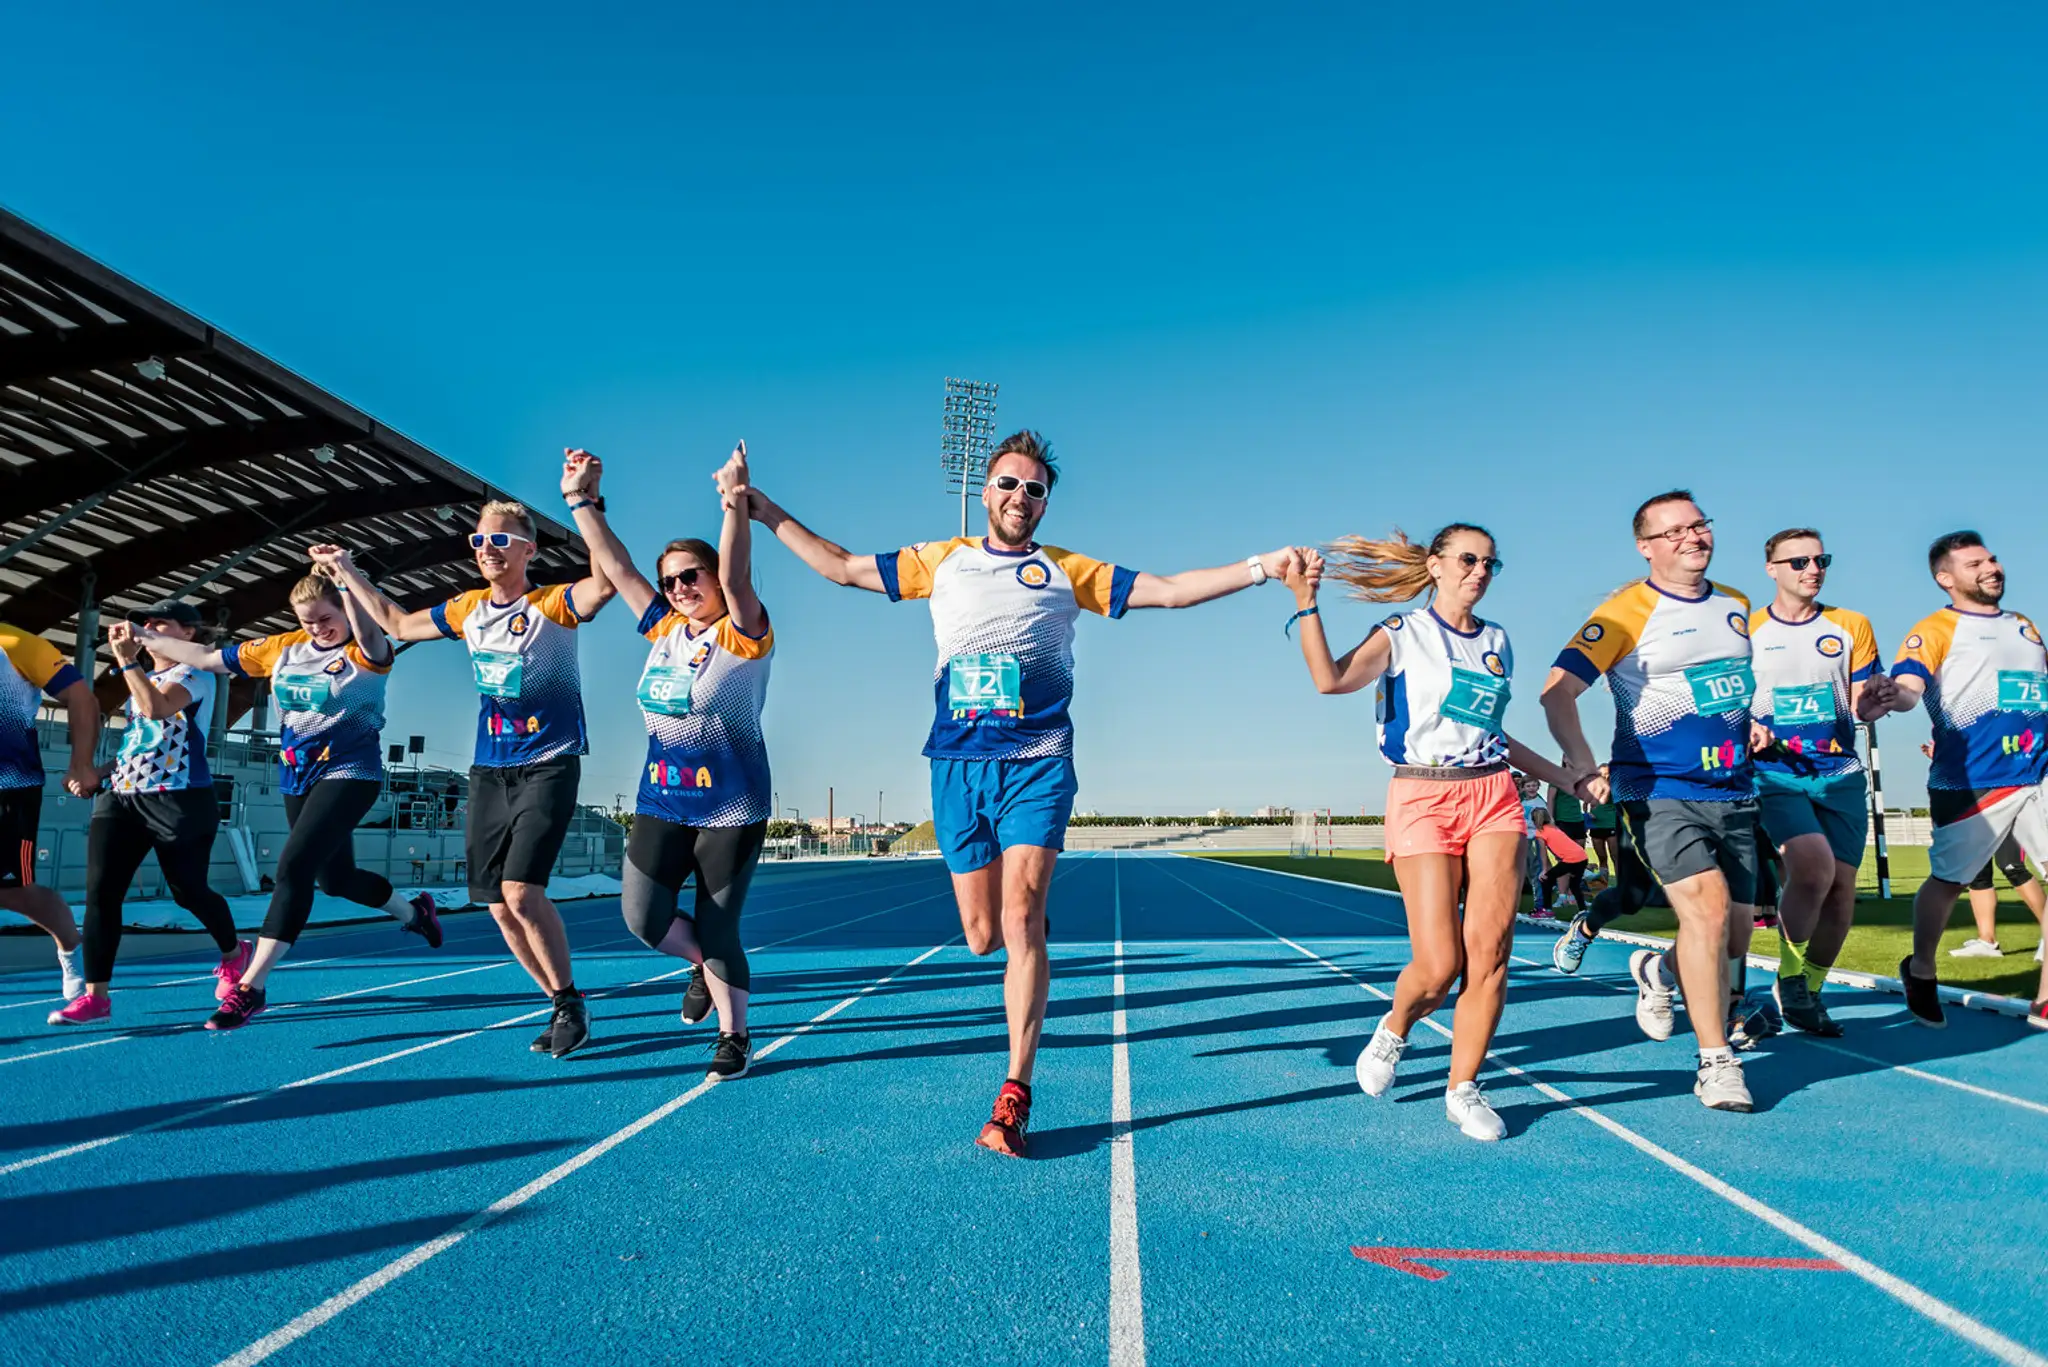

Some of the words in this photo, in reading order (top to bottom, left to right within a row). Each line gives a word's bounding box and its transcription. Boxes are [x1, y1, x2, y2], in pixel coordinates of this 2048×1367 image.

[287, 685, 312, 701] 70
[649, 680, 673, 701] 68
[965, 671, 997, 697] 72
[1705, 674, 1746, 700] 109
[2017, 682, 2042, 700] 75
[1469, 687, 1497, 715] 73
[1789, 696, 1820, 714] 74
